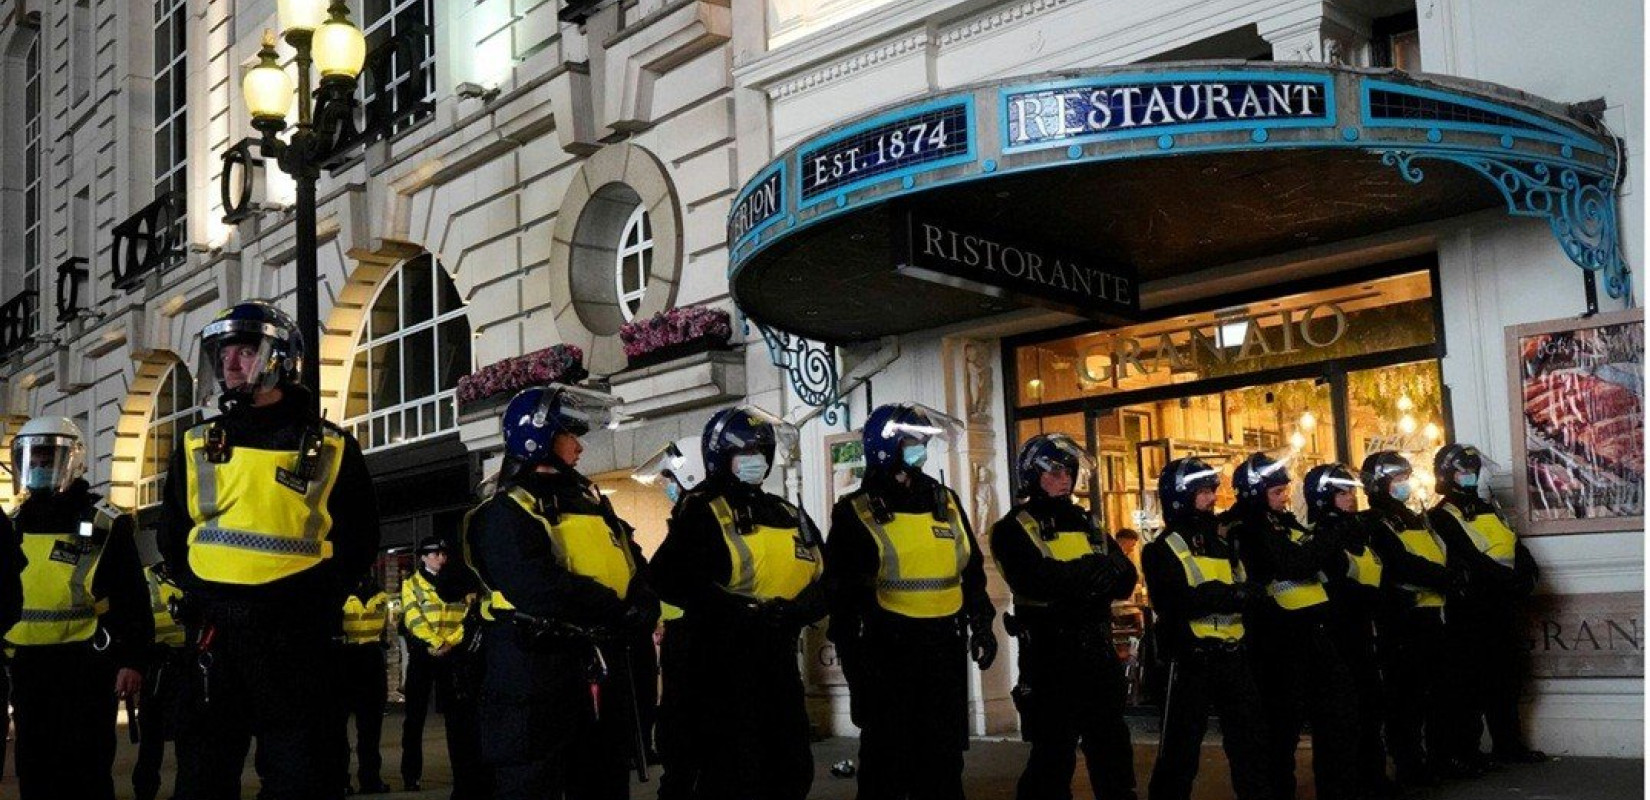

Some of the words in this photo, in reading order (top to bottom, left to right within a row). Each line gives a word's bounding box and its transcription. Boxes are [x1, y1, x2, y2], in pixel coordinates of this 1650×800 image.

[876, 119, 948, 164] 1874
[1014, 84, 1318, 142] RESTAURANT
[921, 222, 1132, 305] RISTORANTE
[1075, 302, 1349, 382] GRANAIO
